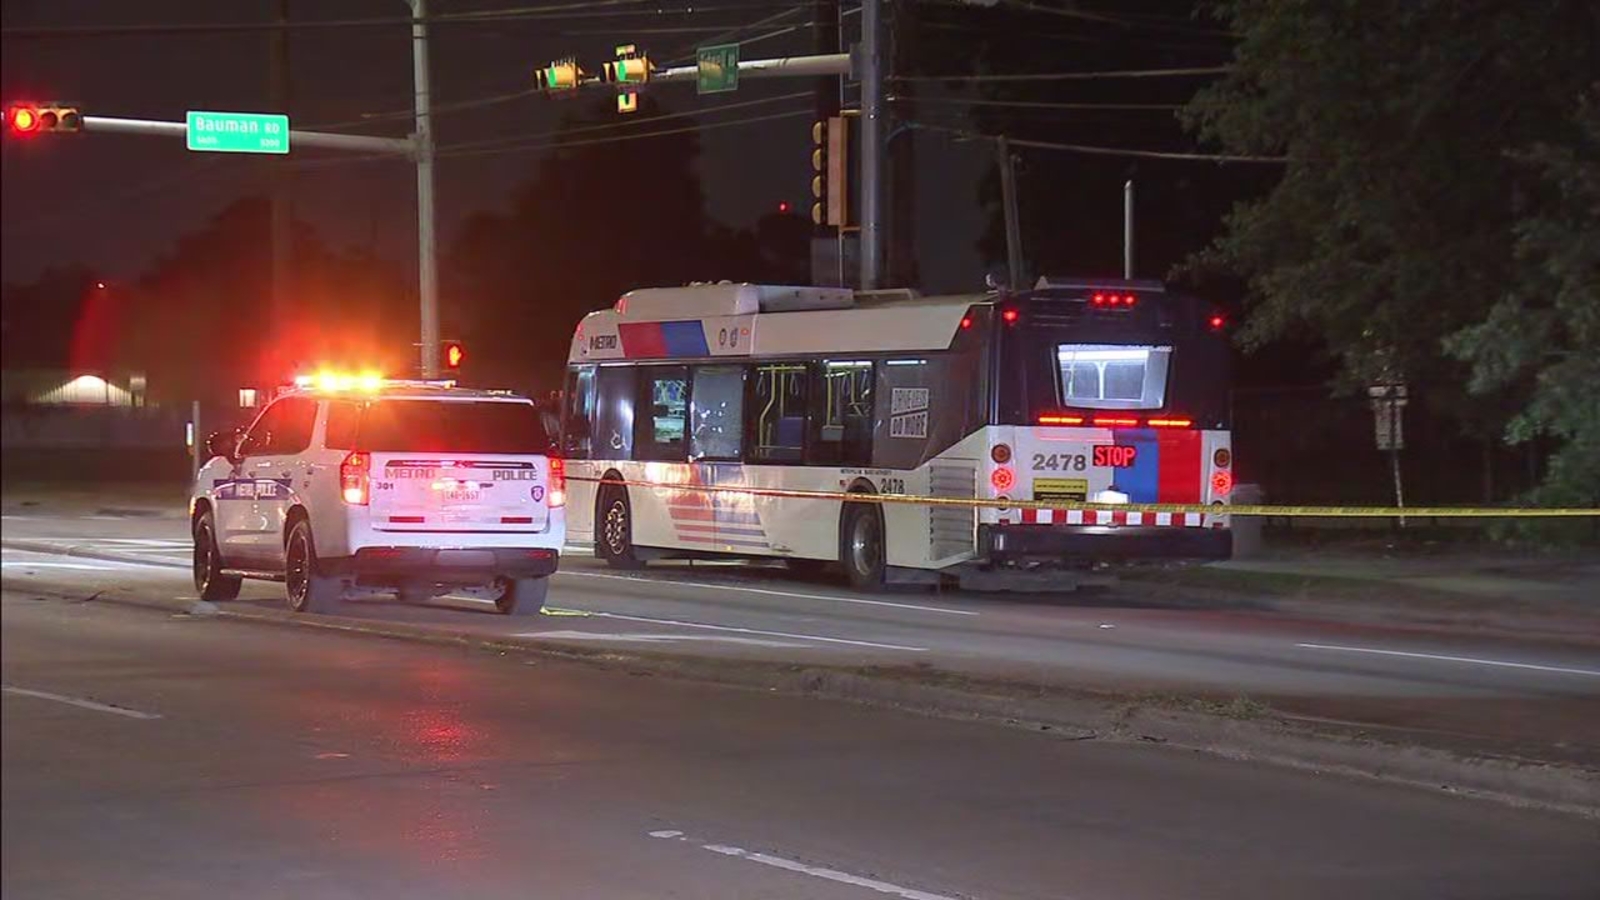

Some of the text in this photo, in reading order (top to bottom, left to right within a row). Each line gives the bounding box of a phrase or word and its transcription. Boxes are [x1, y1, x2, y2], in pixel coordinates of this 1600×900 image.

[196, 117, 258, 133] Bauman
[589, 335, 617, 350] METRO
[892, 388, 911, 412] DRIVE
[891, 412, 927, 437] DO MORE
[1032, 453, 1087, 472] 2478
[1095, 447, 1135, 466] STOP
[385, 469, 538, 482] METRO POLICE
[880, 478, 905, 494] 2478
